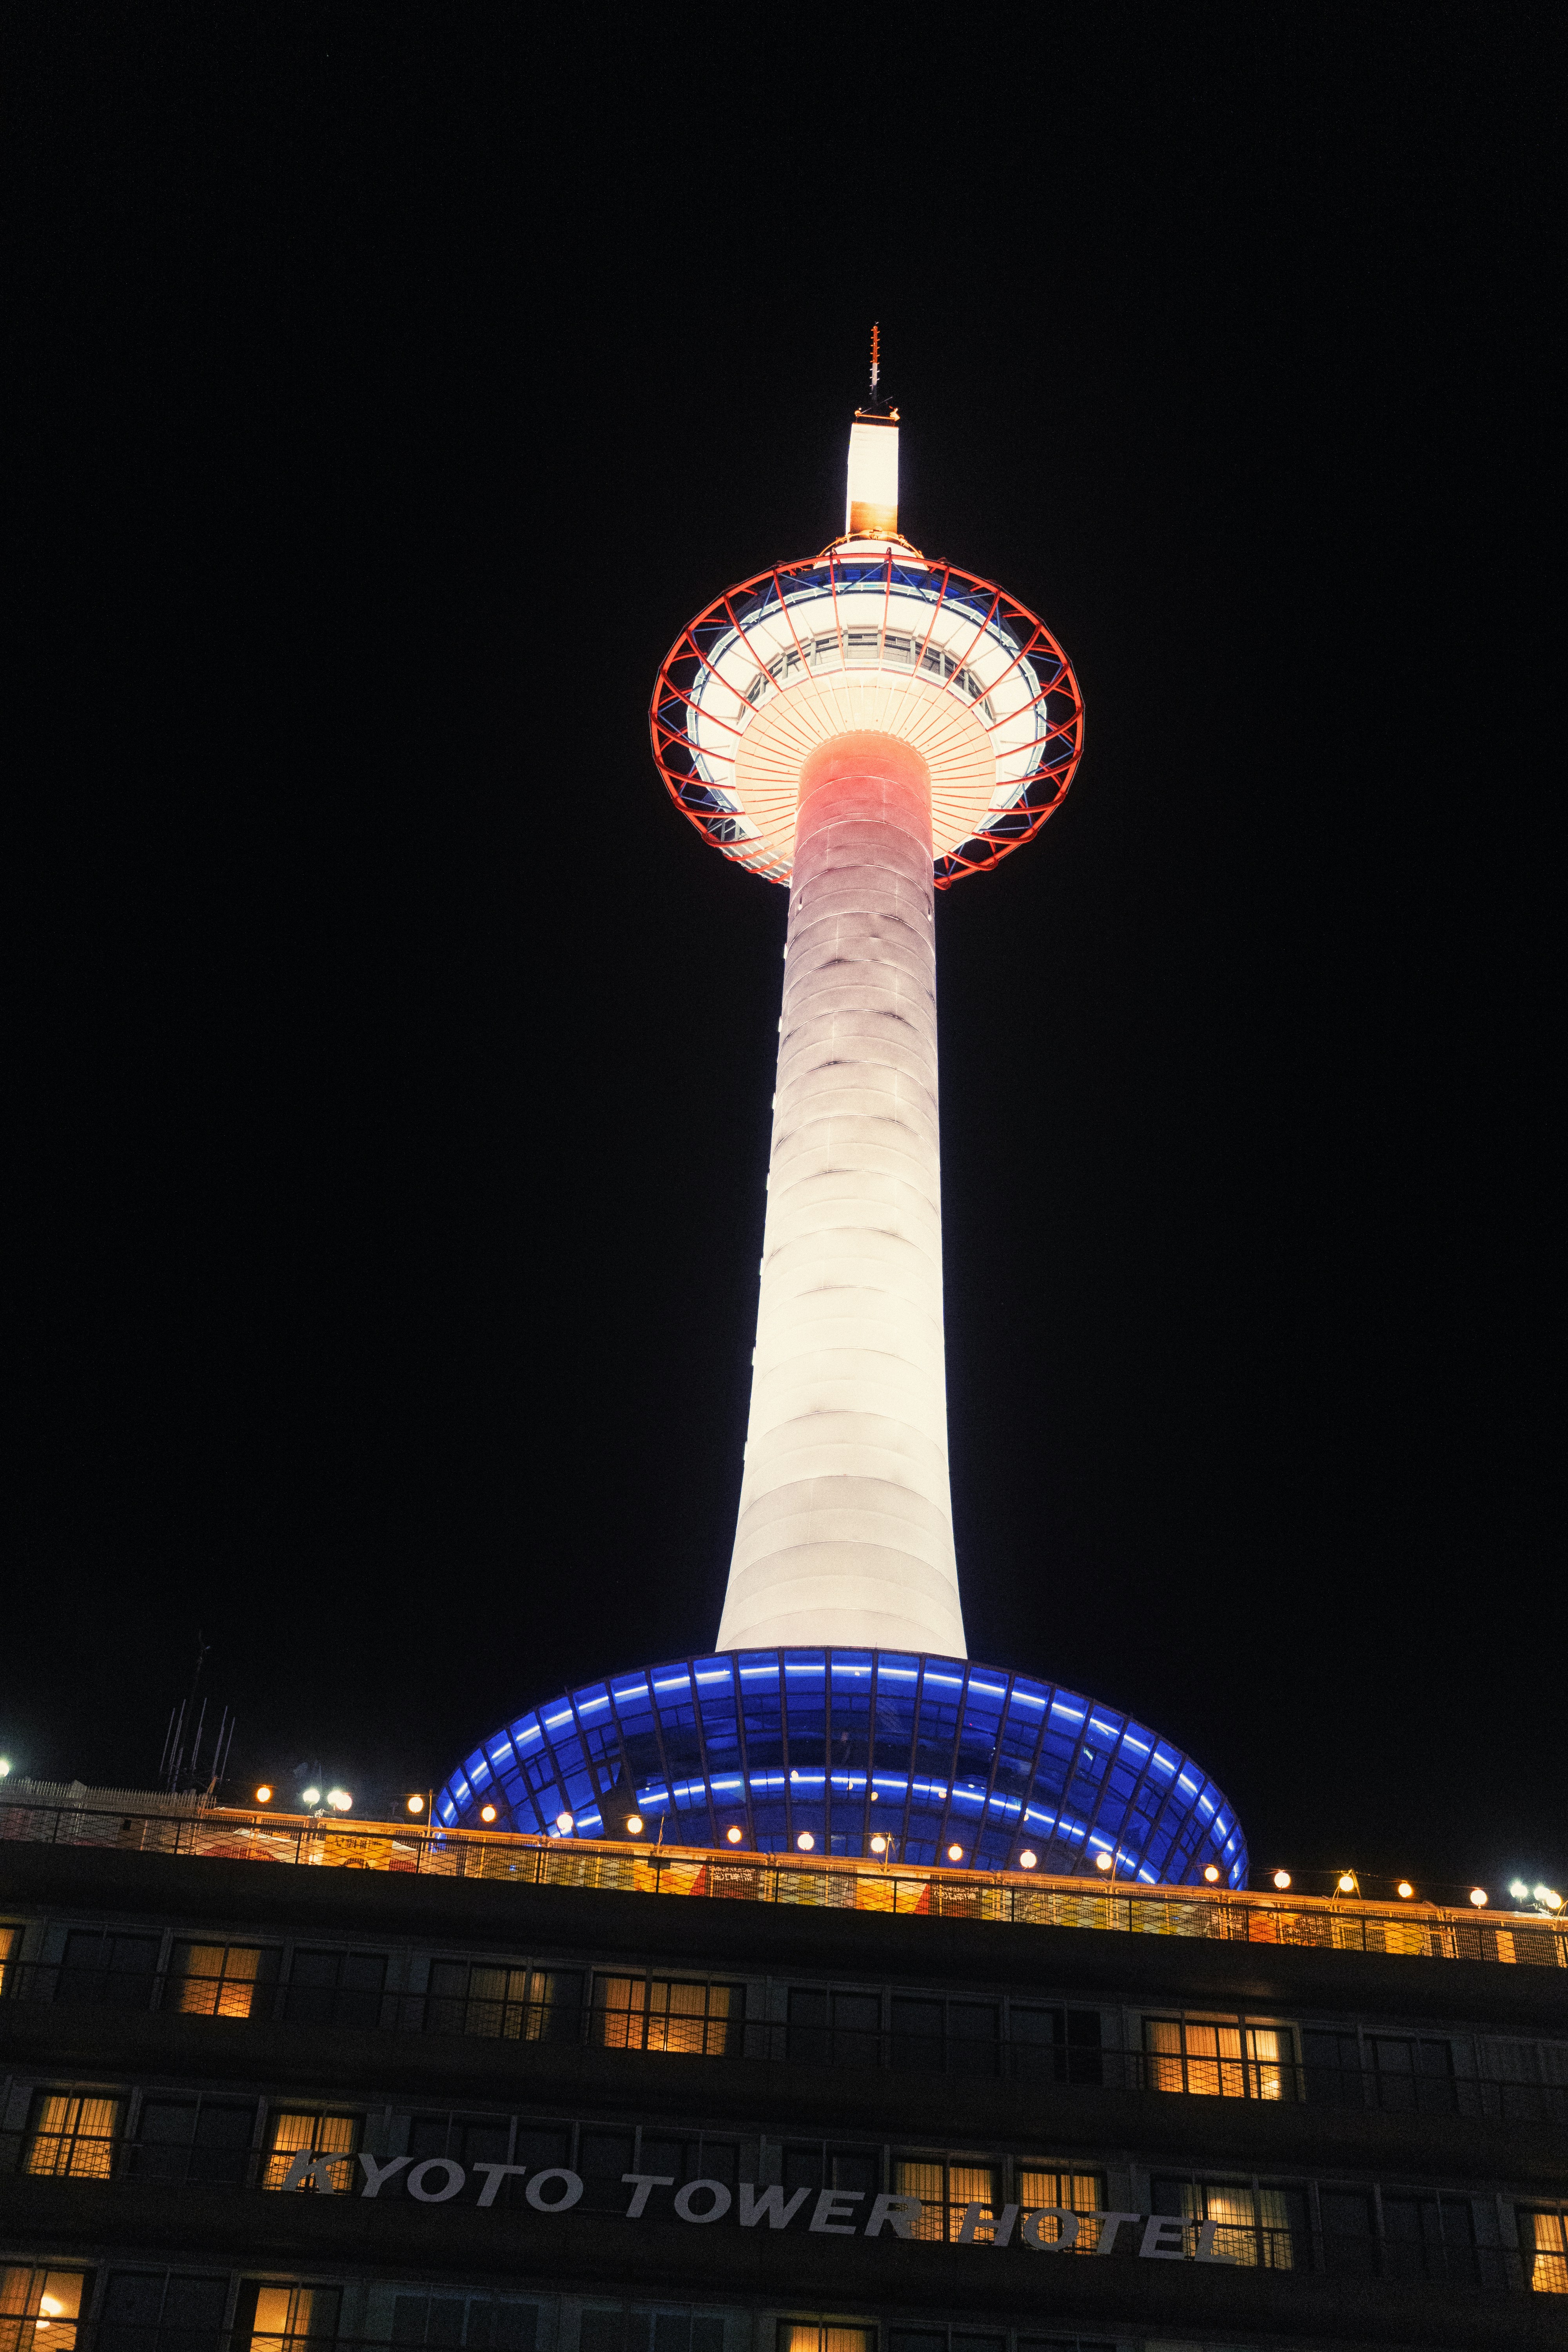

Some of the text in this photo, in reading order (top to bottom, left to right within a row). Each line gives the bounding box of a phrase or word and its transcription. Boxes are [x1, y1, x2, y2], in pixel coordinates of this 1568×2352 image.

[281, 2149, 1237, 2265] KYOTO TOWER HOTEL
